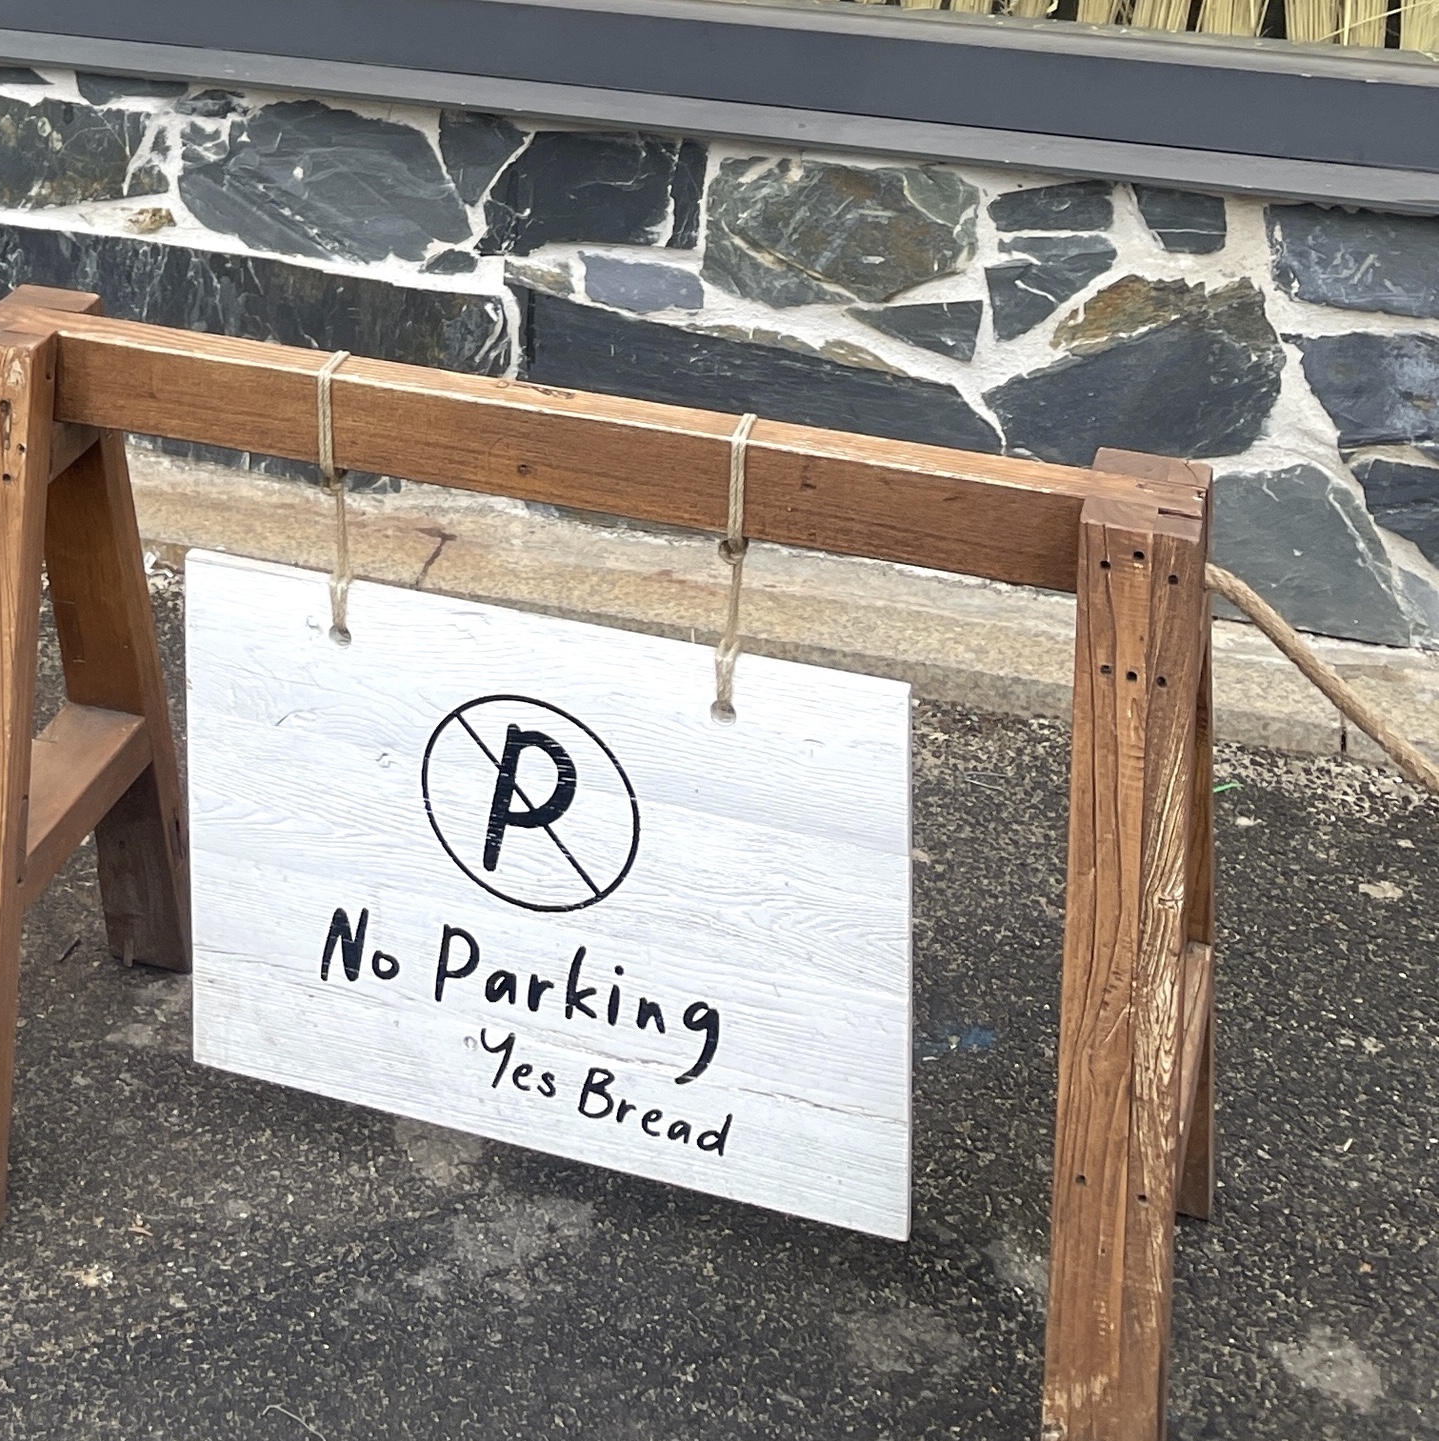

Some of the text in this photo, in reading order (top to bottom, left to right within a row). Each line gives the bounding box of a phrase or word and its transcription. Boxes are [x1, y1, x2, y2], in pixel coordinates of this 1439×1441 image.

[321, 908, 720, 1086] No Parking
[480, 1028, 733, 1158] Yes Bread
